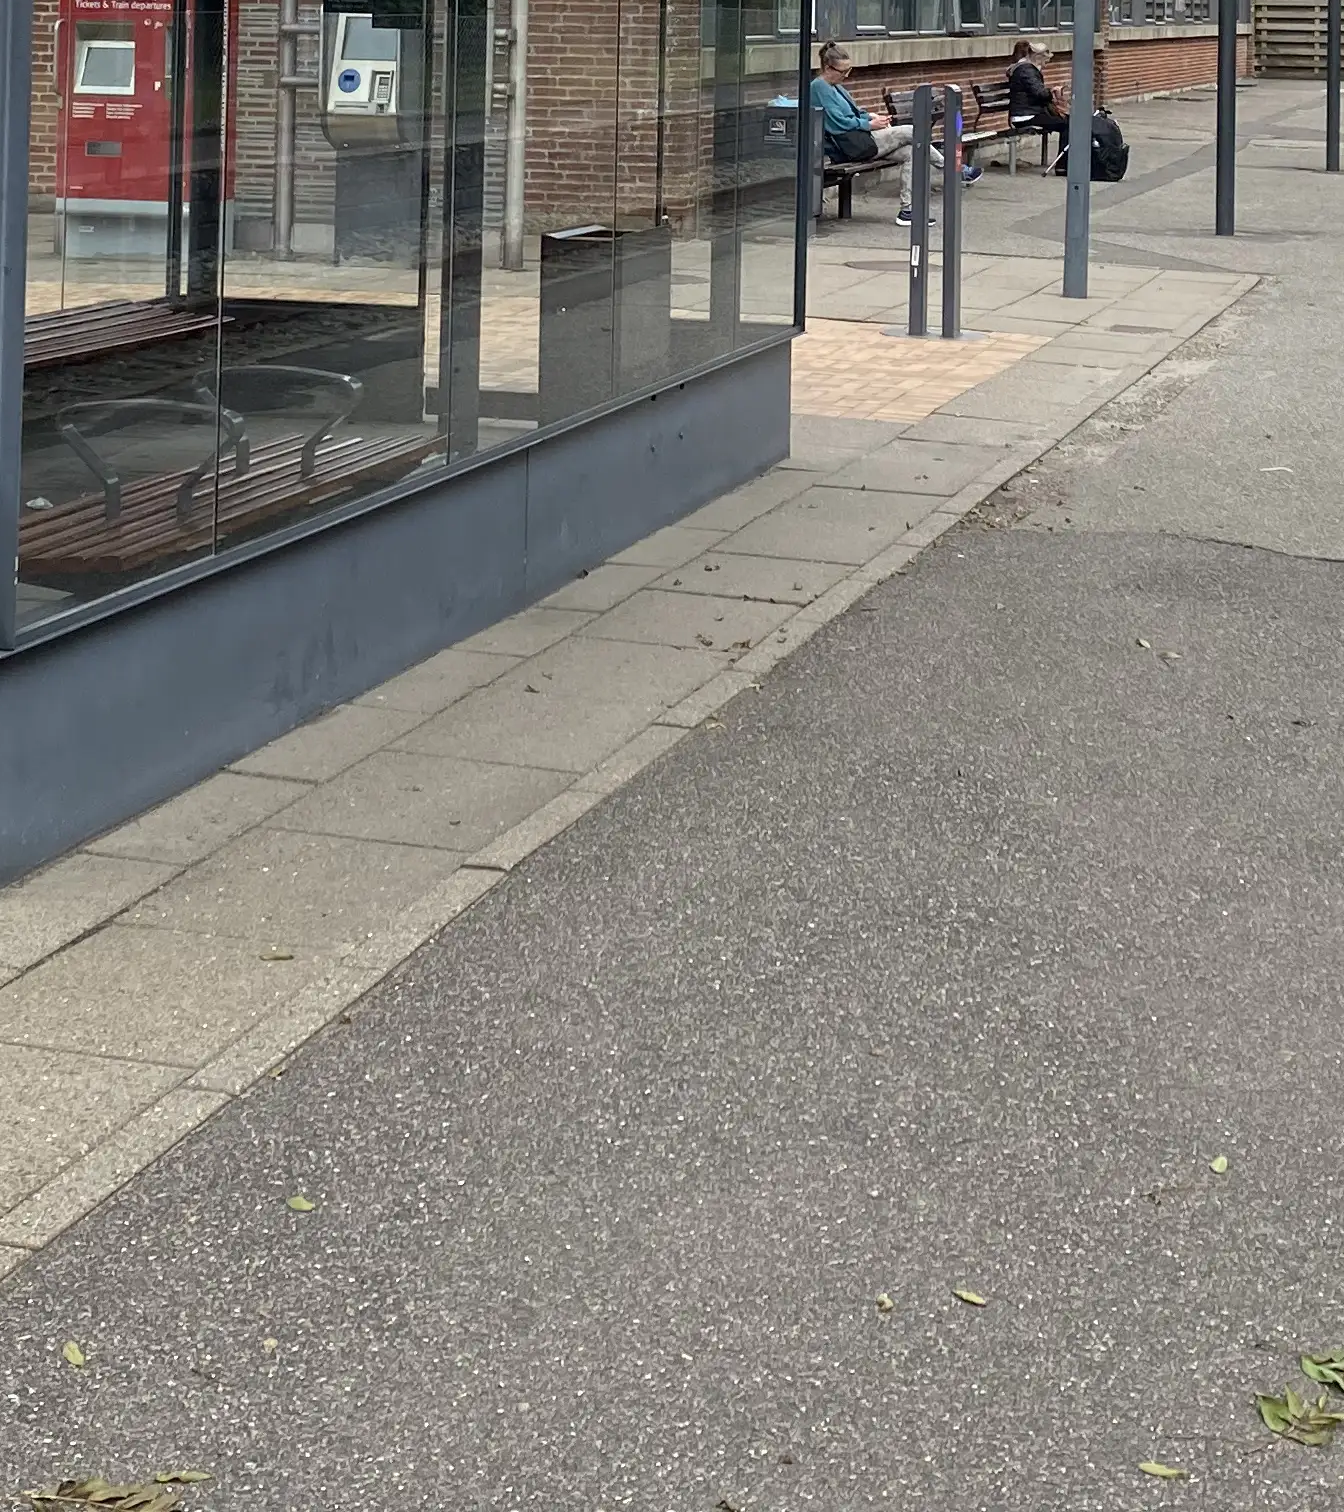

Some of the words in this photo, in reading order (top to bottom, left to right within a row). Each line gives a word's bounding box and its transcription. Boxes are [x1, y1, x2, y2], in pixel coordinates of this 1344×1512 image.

[76, 0, 102, 9] Tickets
[102, 1, 110, 9] &
[111, 1, 130, 9] Train
[130, 2, 172, 11] departures
